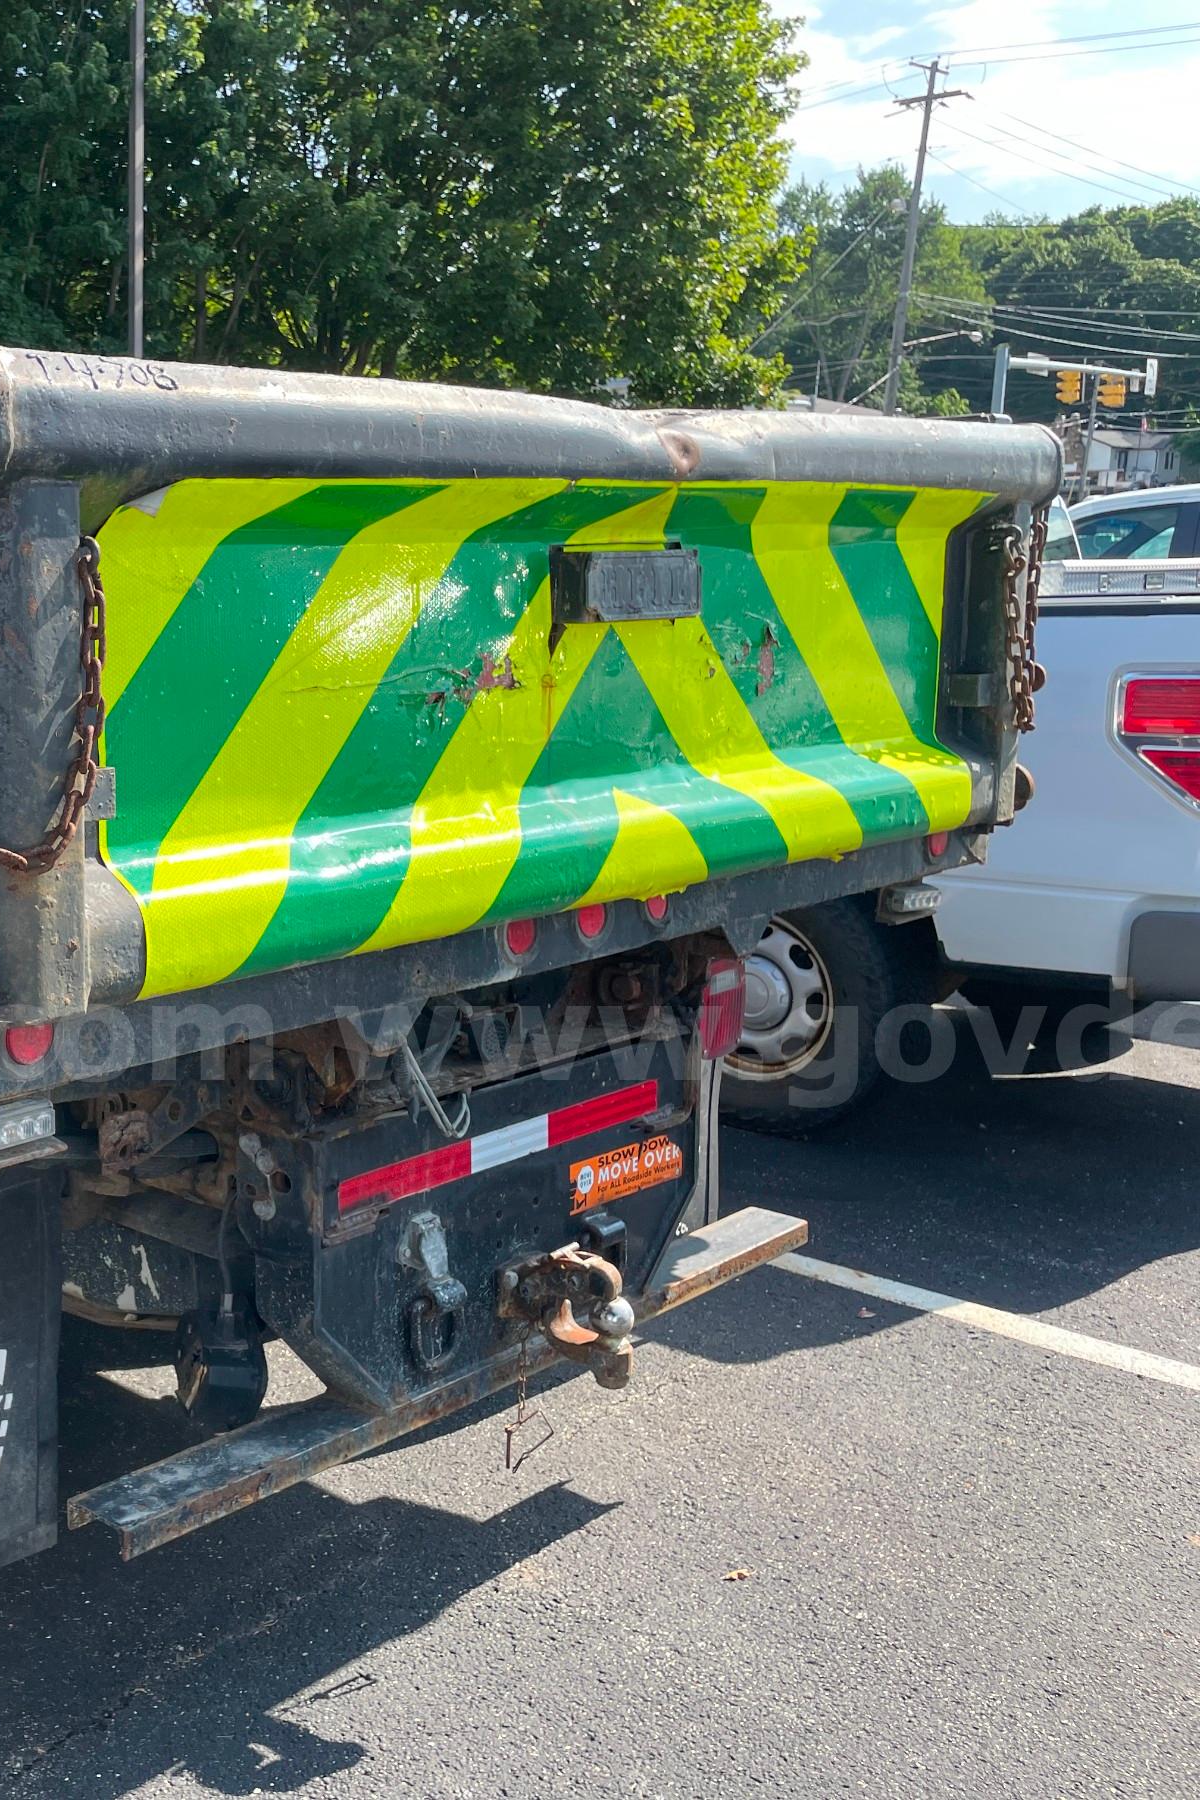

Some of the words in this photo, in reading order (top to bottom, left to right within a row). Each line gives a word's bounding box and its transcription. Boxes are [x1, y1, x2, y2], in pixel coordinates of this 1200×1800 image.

[598, 1147, 635, 1167] SLOW
[598, 1157, 639, 1184] MOVE
[644, 1145, 680, 1168] OVER
[598, 1185, 607, 1193] For
[610, 1181, 621, 1189] ALL
[623, 1171, 652, 1185] Roadside
[654, 1162, 680, 1174] Workers
